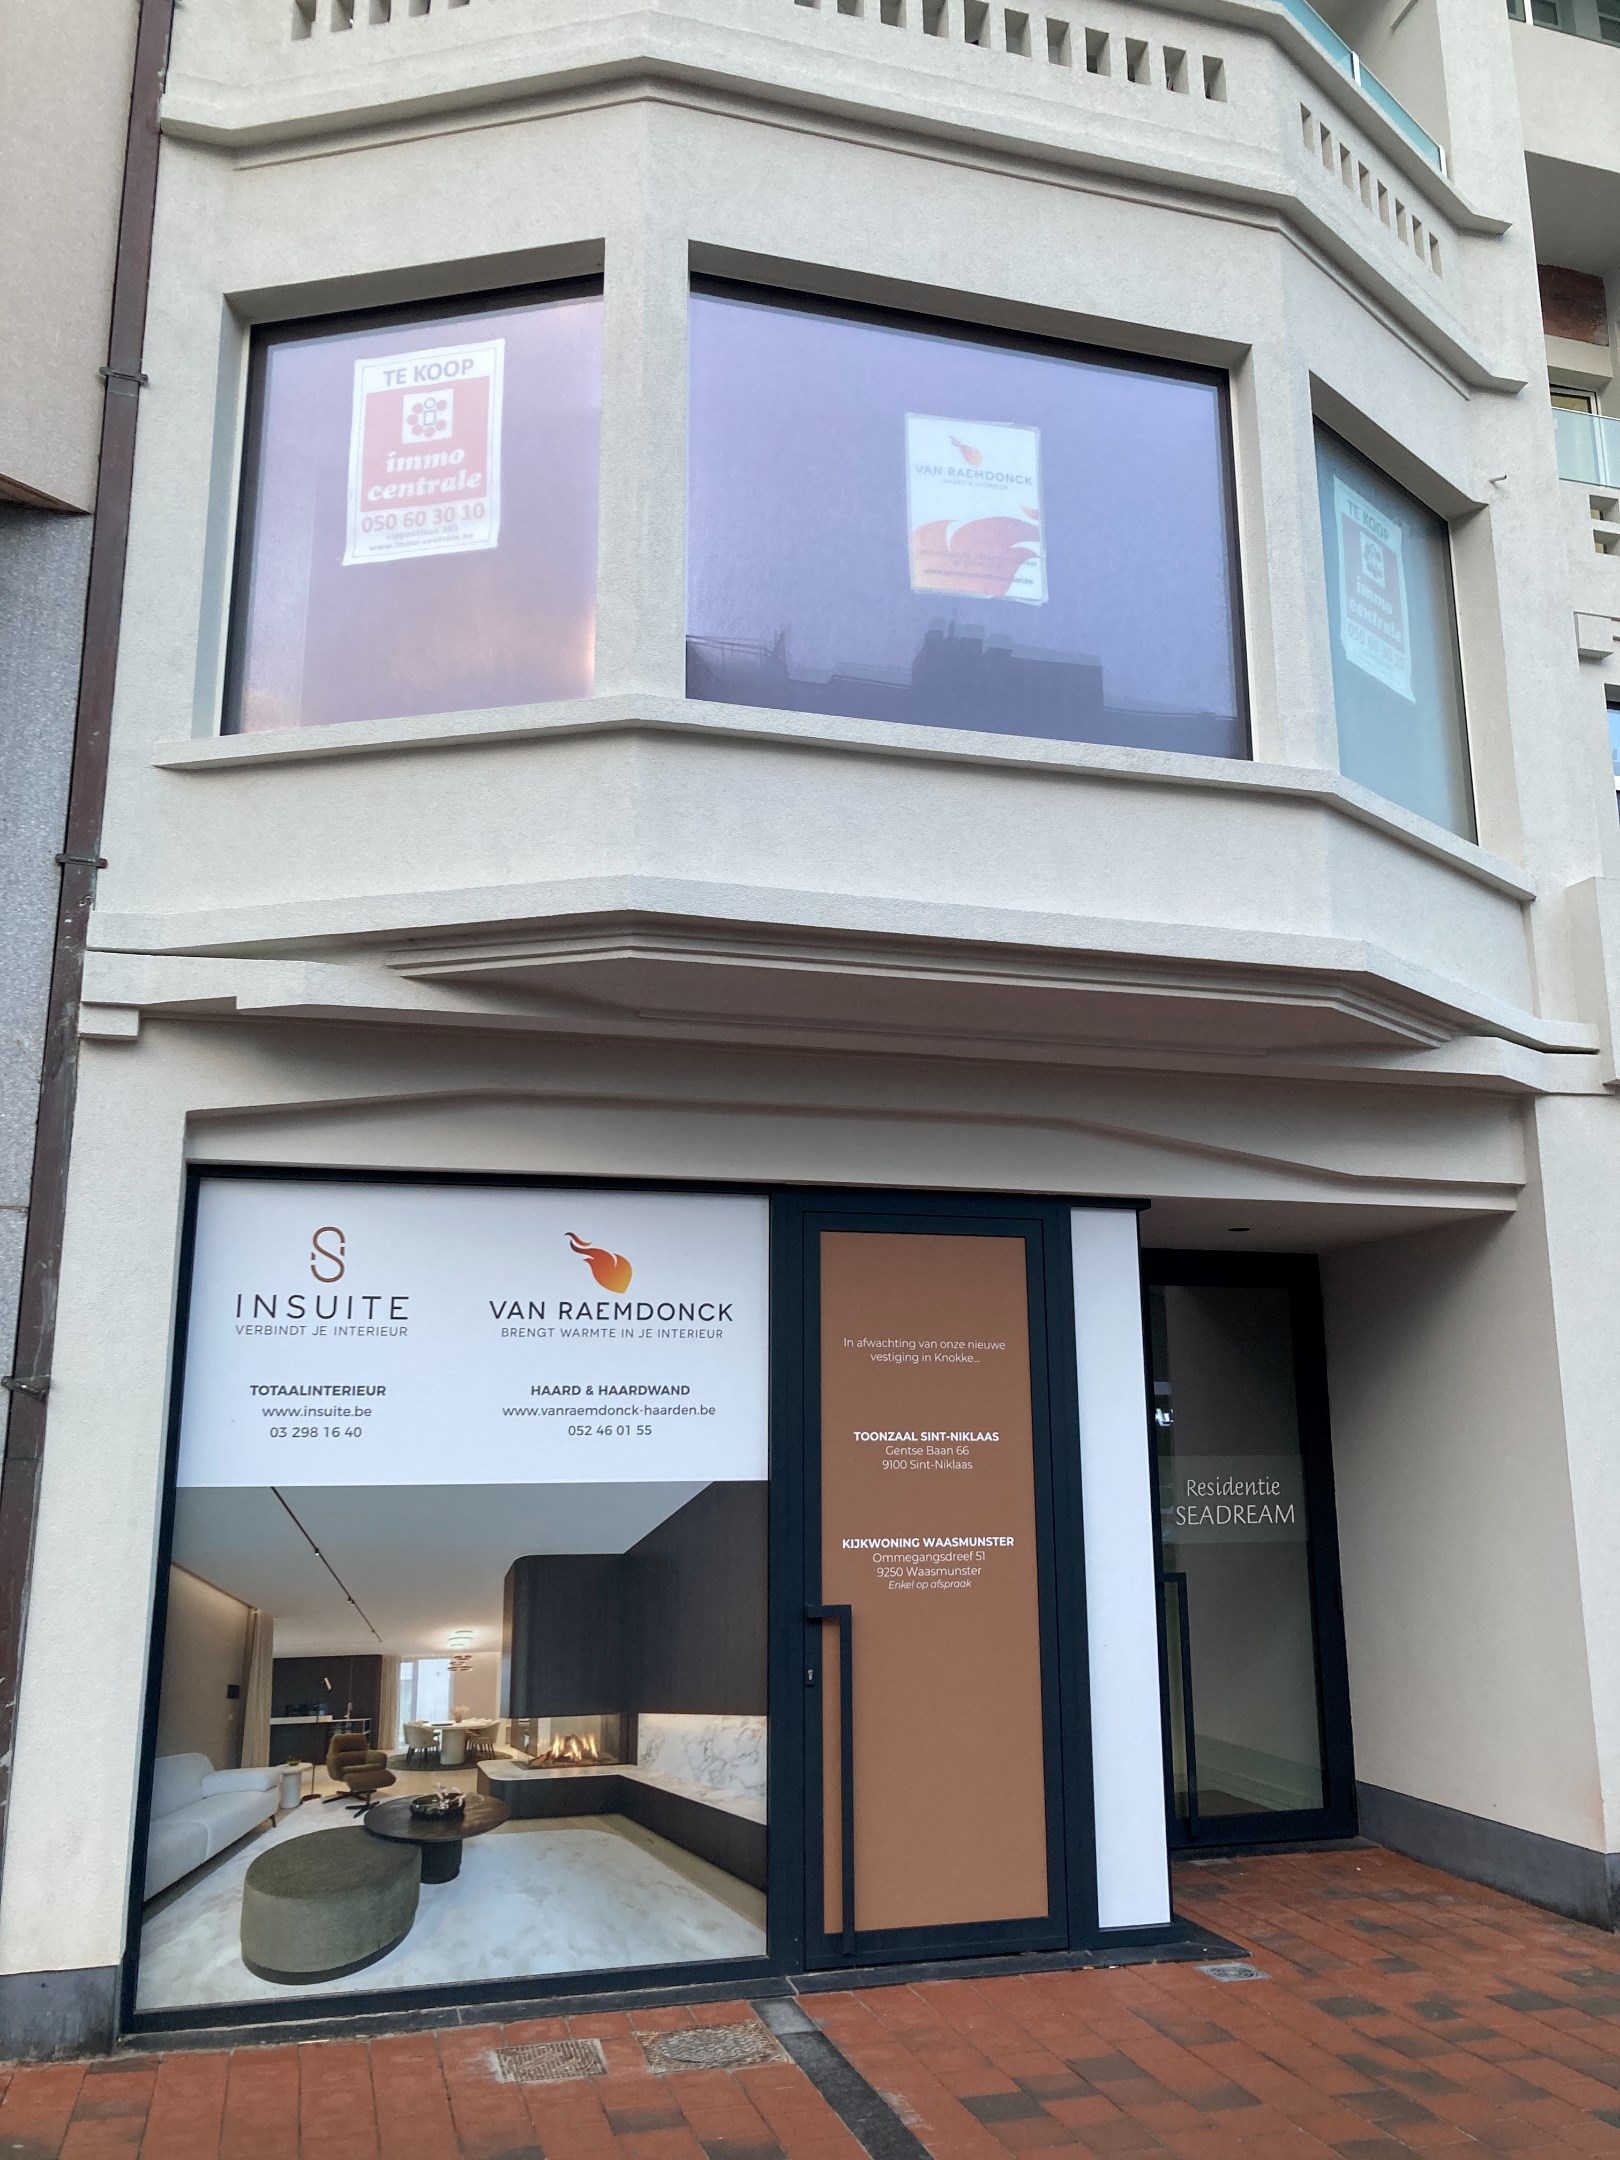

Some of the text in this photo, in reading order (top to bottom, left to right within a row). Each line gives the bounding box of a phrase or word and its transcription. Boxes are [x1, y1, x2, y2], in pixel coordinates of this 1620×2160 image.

[383, 359, 474, 386] TE KOOP
[386, 449, 465, 473] immo
[915, 464, 942, 475] VAN
[949, 467, 1033, 485] RAEMDONCK
[367, 469, 482, 502] centrale
[361, 502, 485, 533] 050 60 30 10
[1347, 500, 1389, 541] TE KOOP
[237, 1294, 409, 1320] INSUITE
[489, 1301, 733, 1321] VAN RAEMDONCK
[235, 1325, 407, 1336] VERBINDT JE INTERIEUR
[502, 1328, 722, 1338] BRENGT WARMTE IN JE INTERIEUR
[844, 1338, 853, 1347] In
[857, 1338, 916, 1350] afwachting
[940, 1341, 965, 1349] onze
[968, 1340, 1005, 1349] nieuwe
[871, 1352, 918, 1364] vestiging
[922, 1353, 931, 1361] in
[250, 1385, 386, 1396] TOTAALINTERIEUR
[531, 1385, 690, 1395] HAARD & HAARDWAND
[262, 1406, 372, 1416] www.insuite.be
[503, 1404, 715, 1416] www.vanraemdonck-haarden.be
[270, 1427, 362, 1437] 03 298 16 40
[568, 1425, 652, 1436] 052 46 01 55
[854, 1432, 999, 1441] TOONZAAL SINT-NIKLAAS
[886, 1446, 969, 1455] Gentse Baan 66
[882, 1459, 973, 1469] 9100 Sint-Niklaas
[1187, 1477, 1280, 1496] Residentie
[1176, 1504, 1294, 1525] SEADREAM
[843, 1537, 1014, 1548] KIJKWONING WAASMUNSTER
[873, 1551, 985, 1564] Ommegangsdreef 51
[877, 1567, 982, 1577] 9250 Waasmunster
[889, 1579, 971, 1590] Enkel op afspraak
